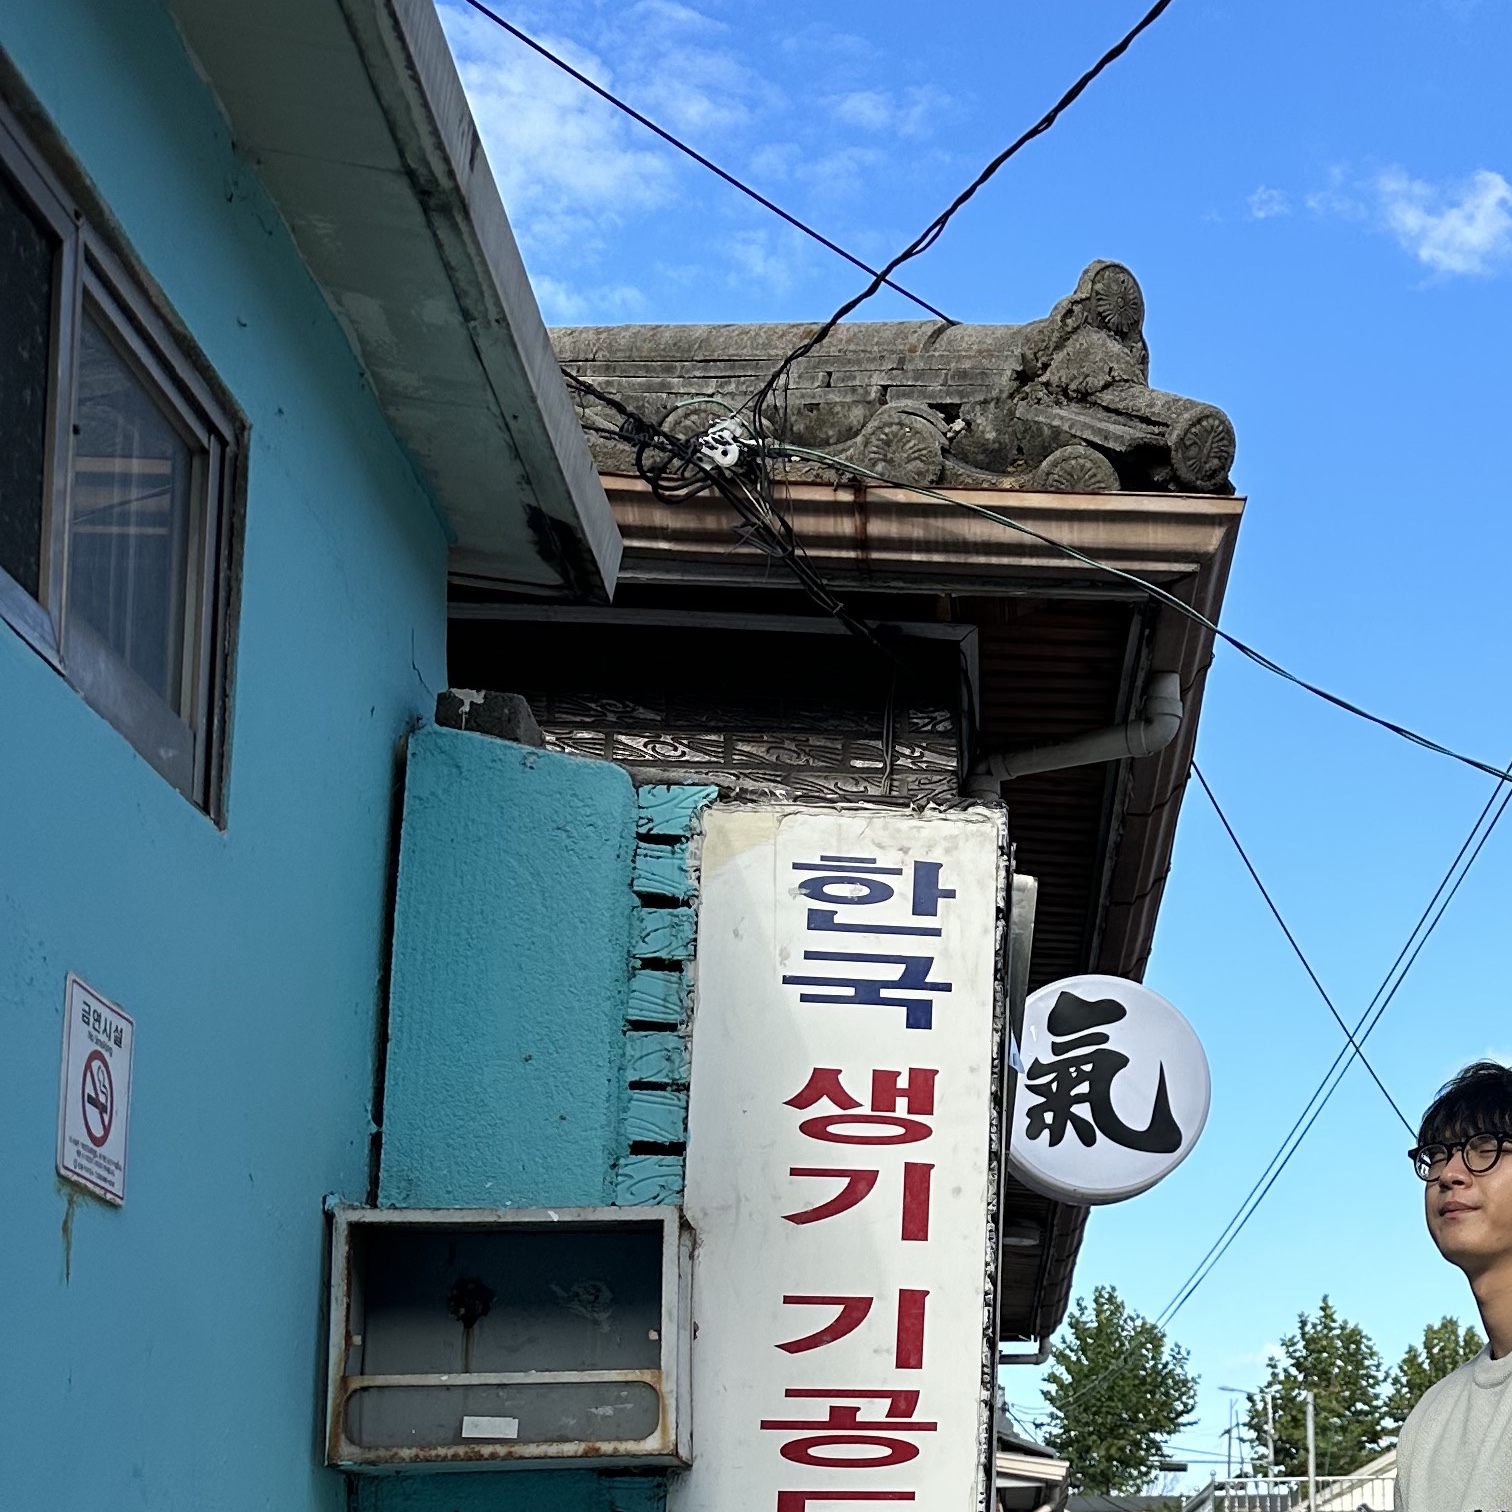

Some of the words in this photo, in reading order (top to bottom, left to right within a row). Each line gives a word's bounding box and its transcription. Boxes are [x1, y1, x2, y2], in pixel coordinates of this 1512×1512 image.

[81, 1000, 123, 1048] 금연시설
[783, 855, 956, 1030] 한국
[782, 1068, 940, 1242] 생기
[1024, 990, 1183, 1154] 氣
